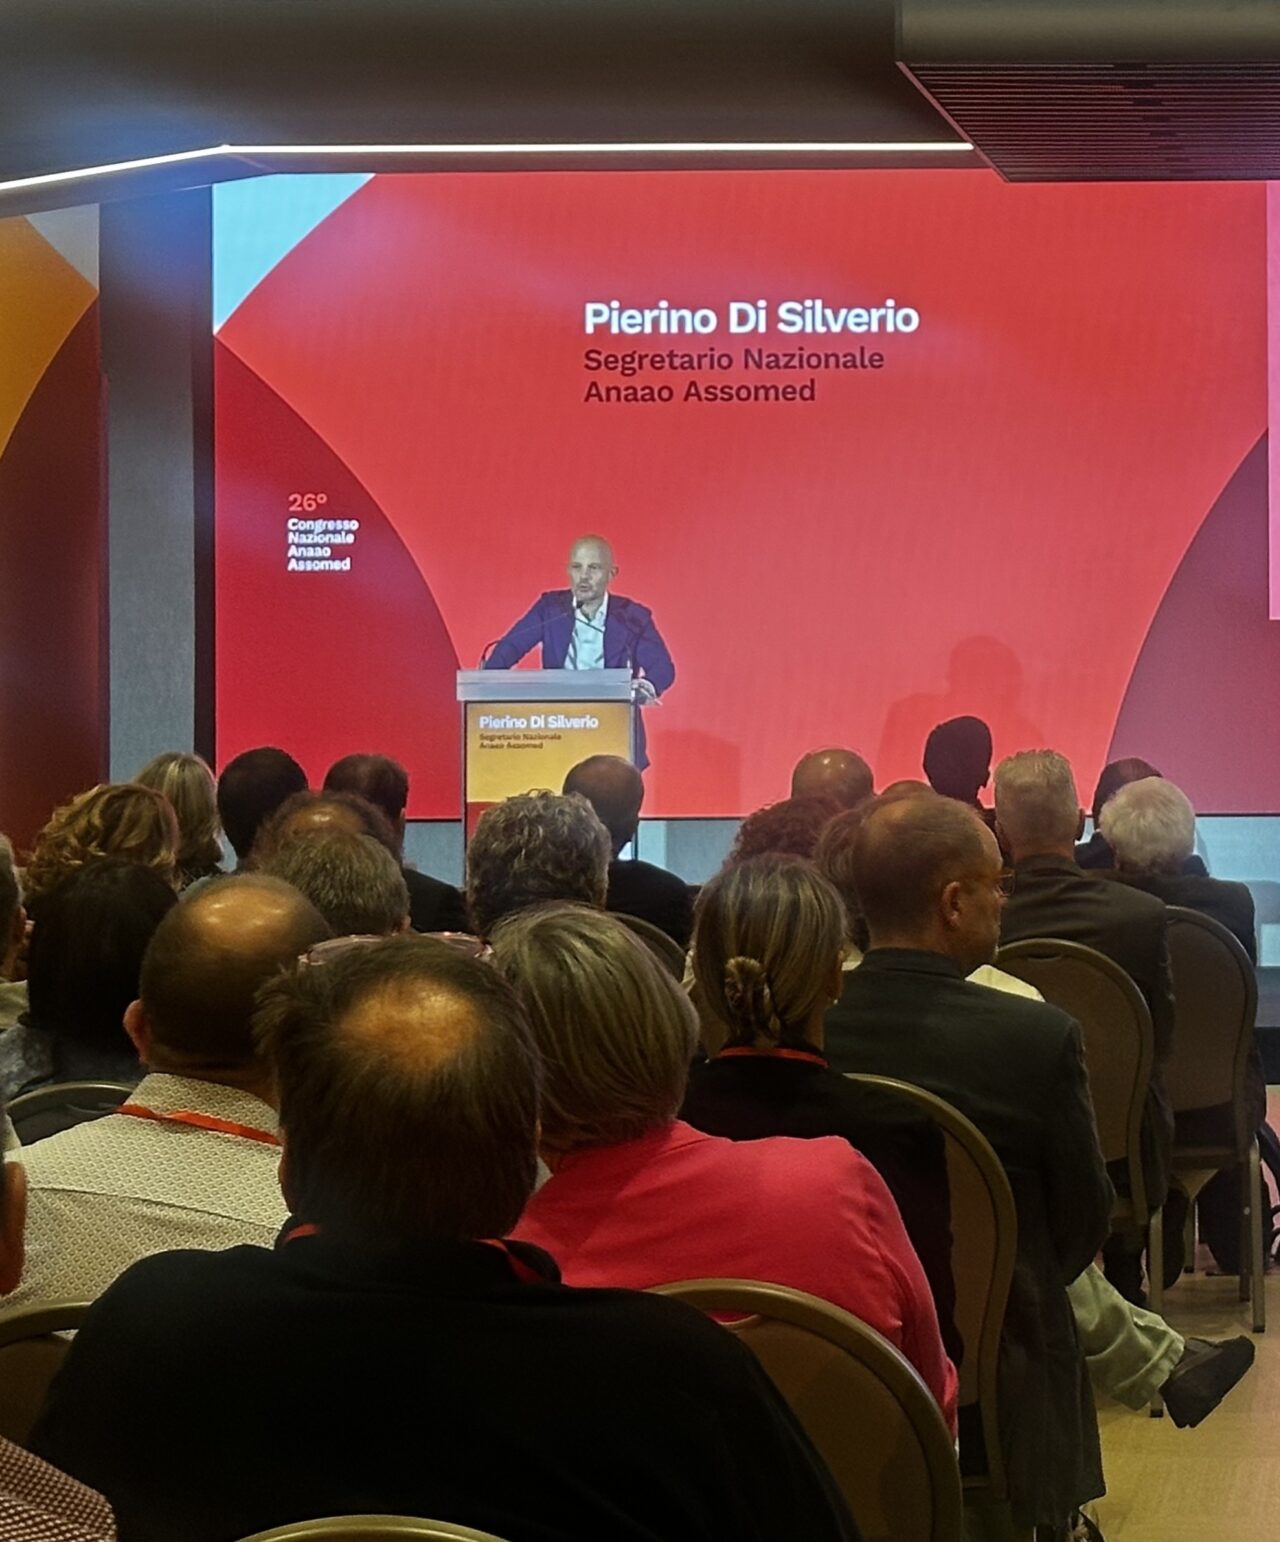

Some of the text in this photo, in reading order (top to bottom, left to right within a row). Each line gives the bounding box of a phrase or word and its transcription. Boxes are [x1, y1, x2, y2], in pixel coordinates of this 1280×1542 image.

[585, 298, 920, 334] Pierino Di Silverio
[584, 346, 885, 376] Segretario Nazionale
[584, 378, 816, 402] Anaao Assomed
[287, 518, 360, 533] Congresso
[288, 531, 355, 544] Nazionale
[287, 545, 332, 557] Anaao
[287, 557, 351, 571] Assomed
[480, 714, 599, 729] Pierino Di Silverio
